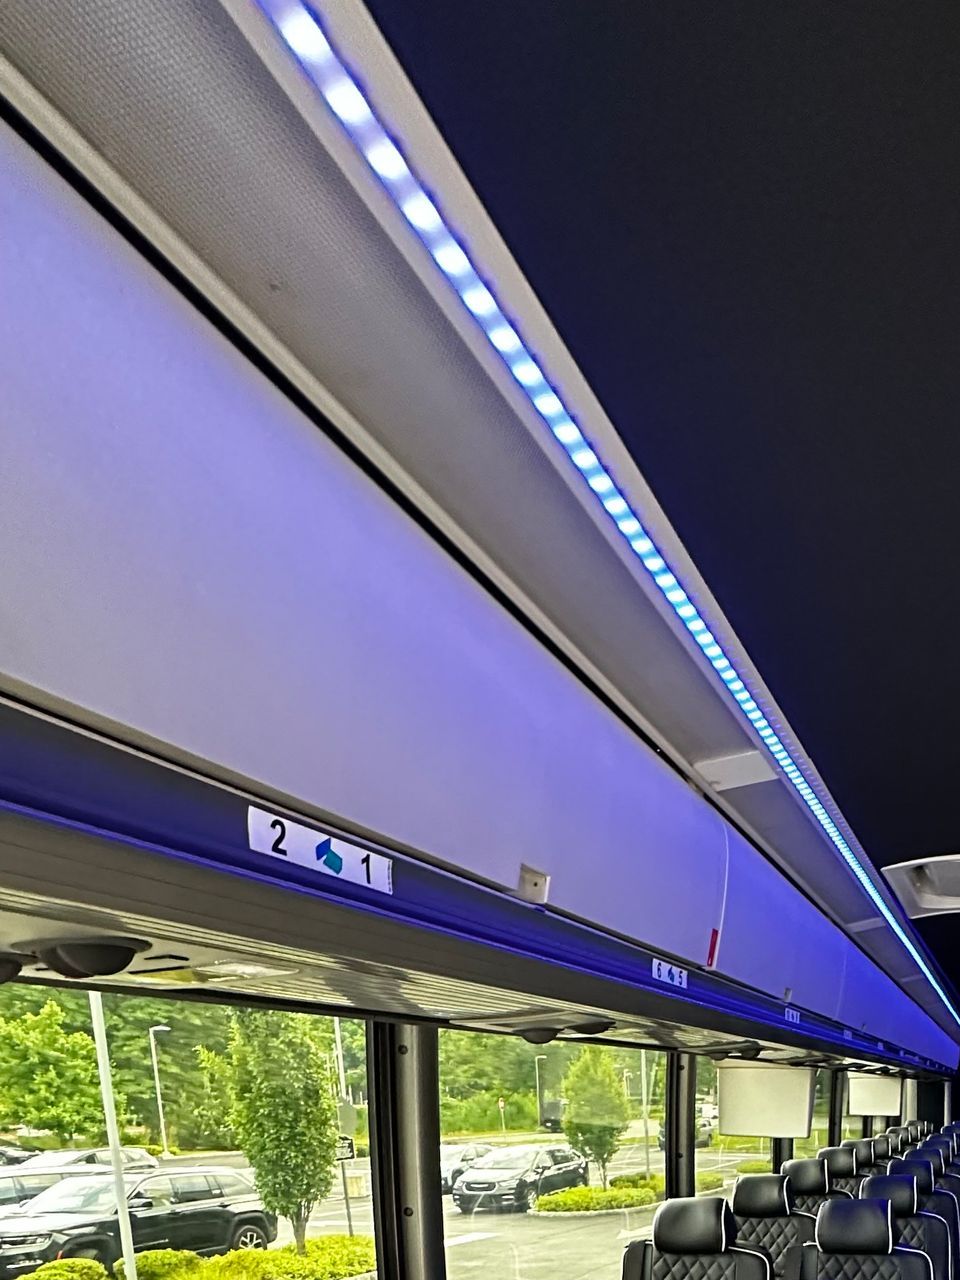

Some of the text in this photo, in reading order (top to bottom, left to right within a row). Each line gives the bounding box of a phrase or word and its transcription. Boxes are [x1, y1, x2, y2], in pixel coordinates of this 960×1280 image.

[270, 819, 287, 856] 2
[361, 853, 371, 884] 1
[657, 961, 683, 986] 6 5
